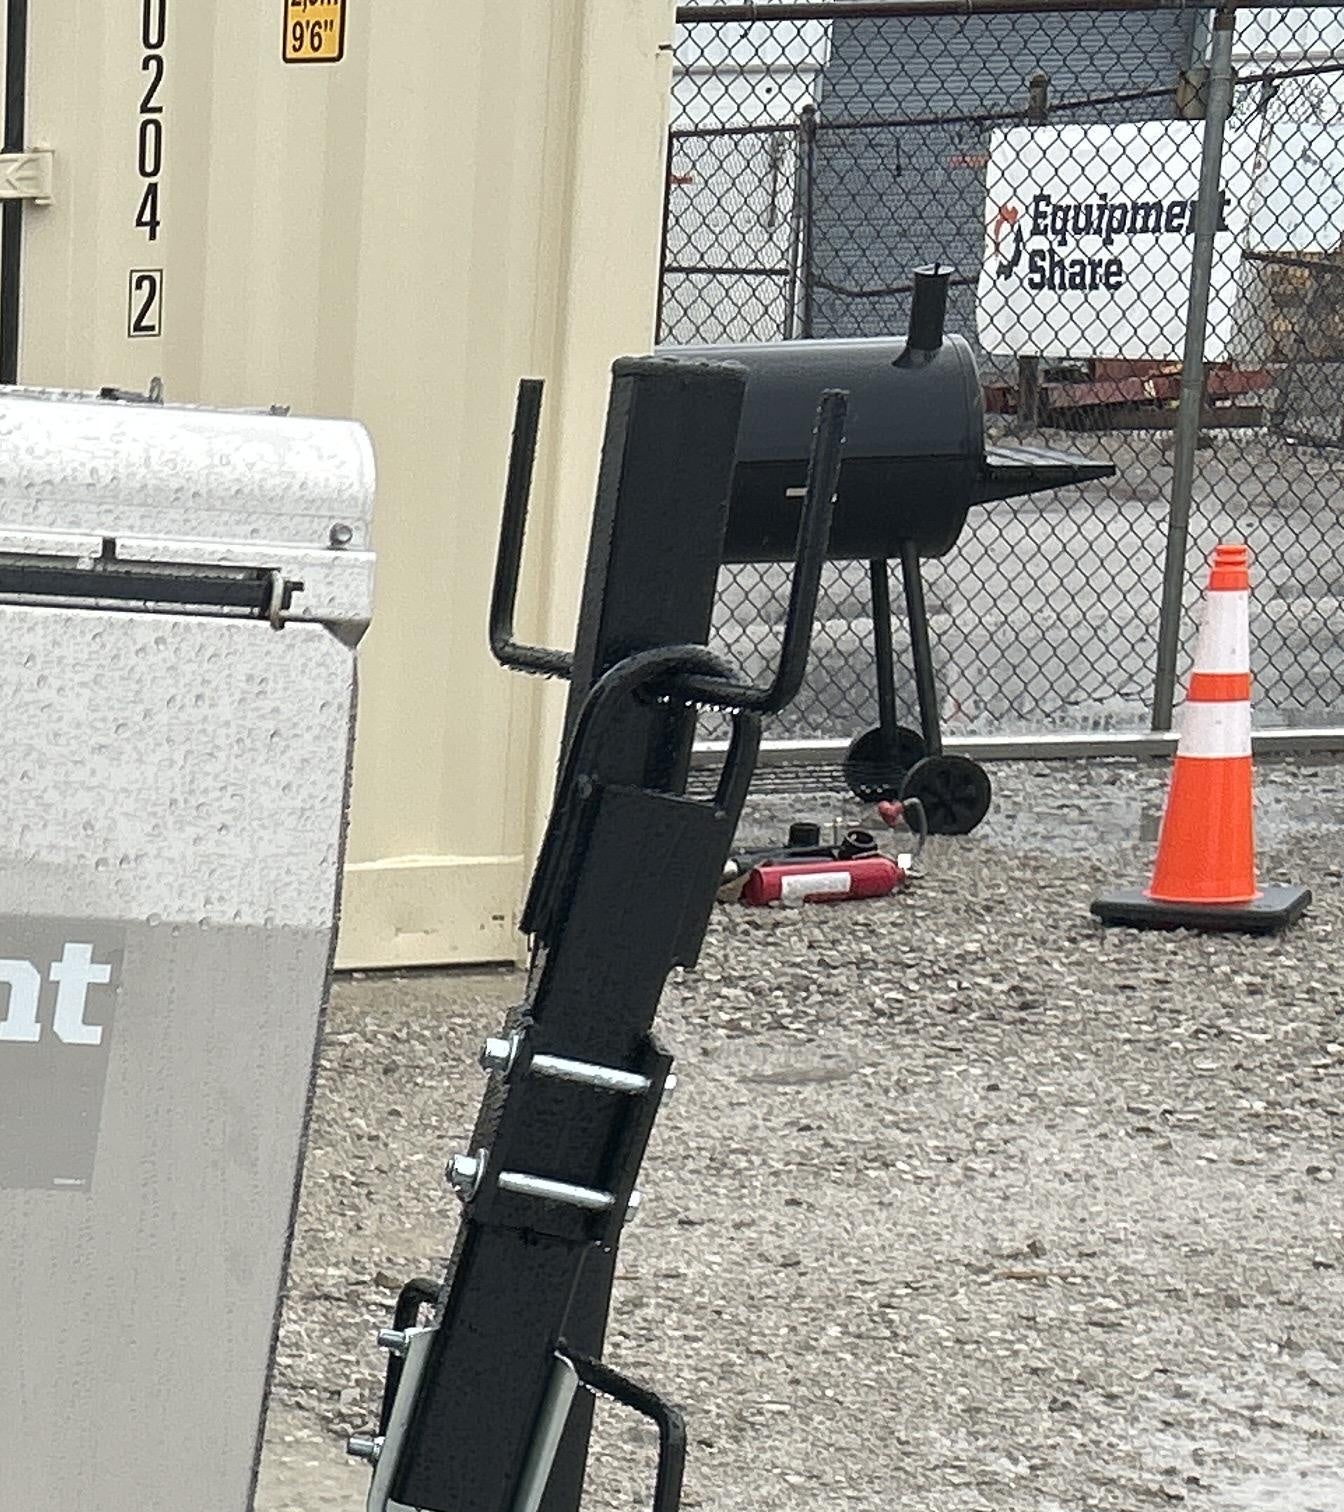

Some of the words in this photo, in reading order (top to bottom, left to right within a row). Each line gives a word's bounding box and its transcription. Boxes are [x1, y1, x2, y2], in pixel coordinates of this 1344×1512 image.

[291, 19, 335, 53] 9'6"
[1027, 248, 1125, 291] Share
[131, 272, 158, 333] 2
